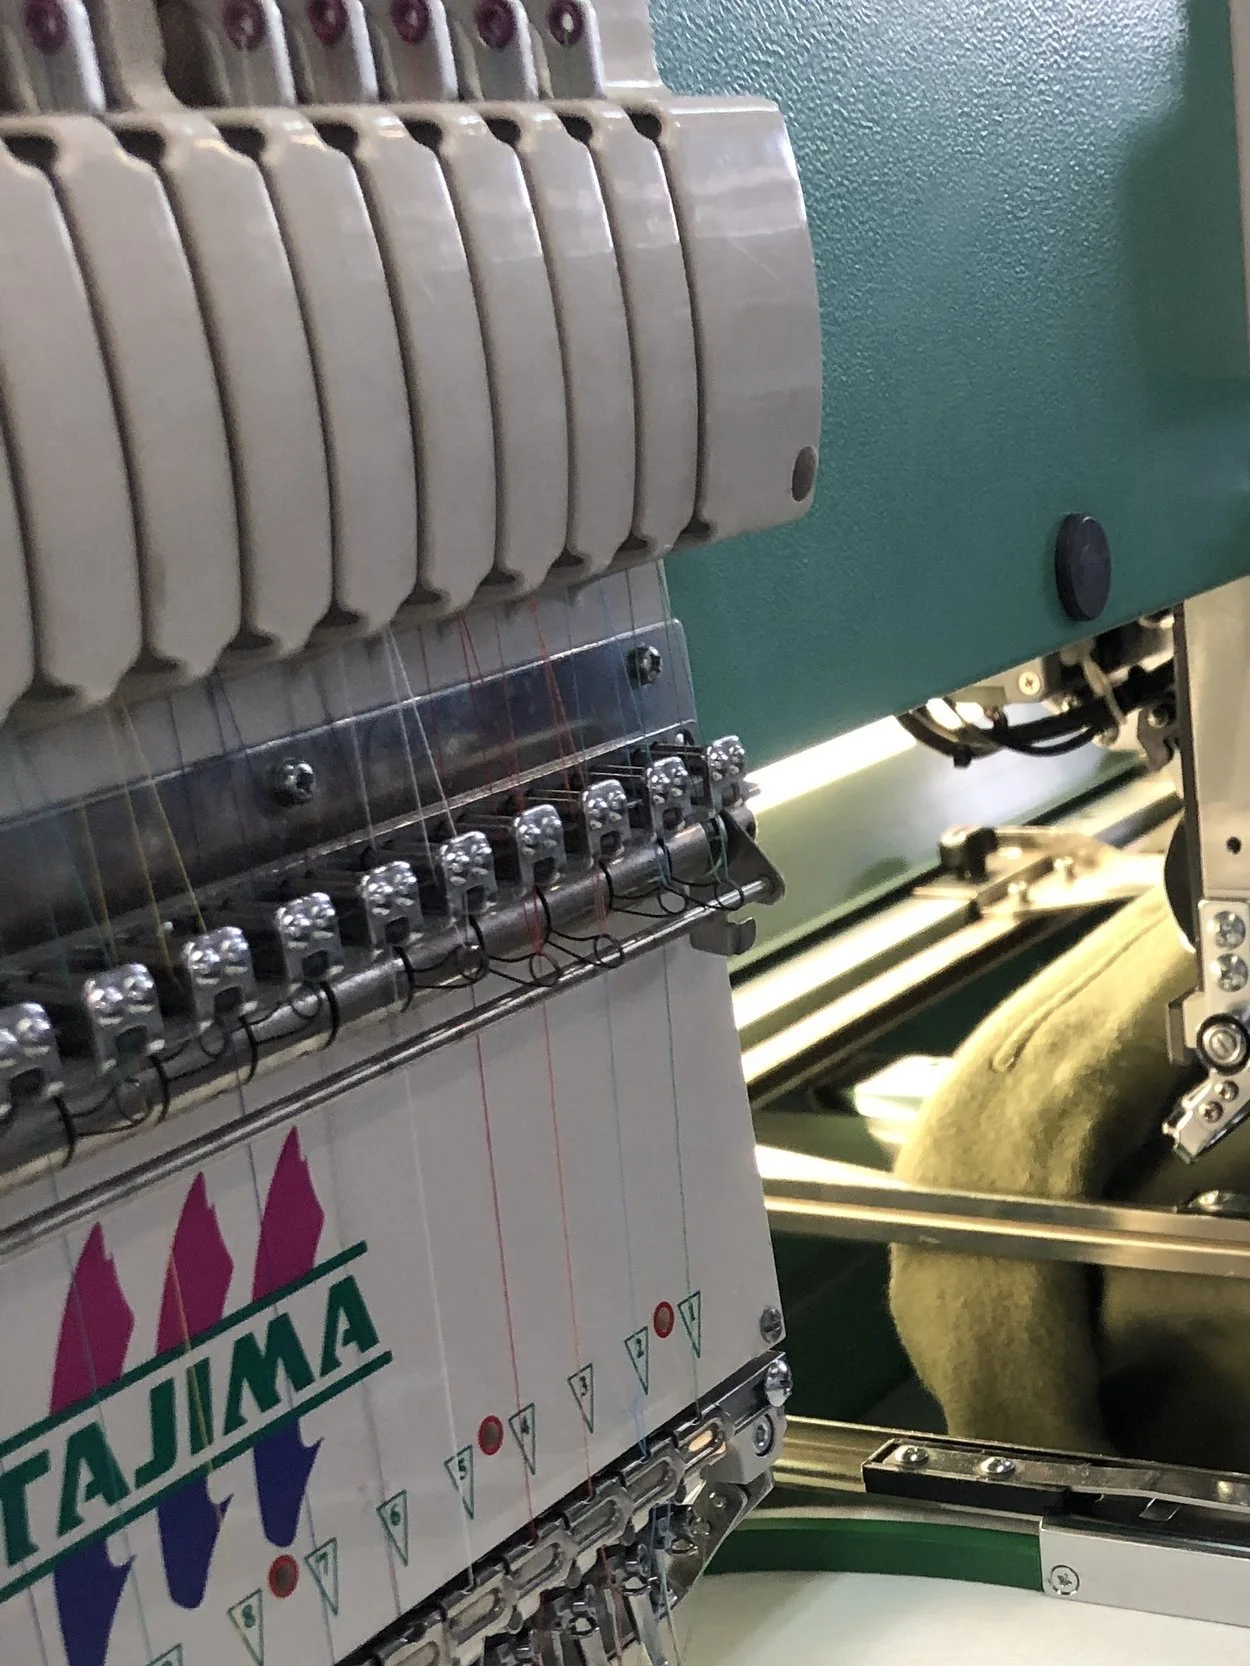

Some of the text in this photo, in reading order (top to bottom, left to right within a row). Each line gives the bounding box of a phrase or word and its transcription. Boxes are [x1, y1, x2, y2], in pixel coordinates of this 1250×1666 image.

[688, 1300, 697, 1322] 1
[635, 1337, 645, 1359] 2
[579, 1375, 589, 1398] 3
[0, 1275, 378, 1565] TAJIMA
[519, 1415, 530, 1435] 4
[457, 1457, 468, 1481] 5
[389, 1503, 401, 1526] 6
[316, 1551, 329, 1576] 7
[241, 1604, 256, 1629] 8
